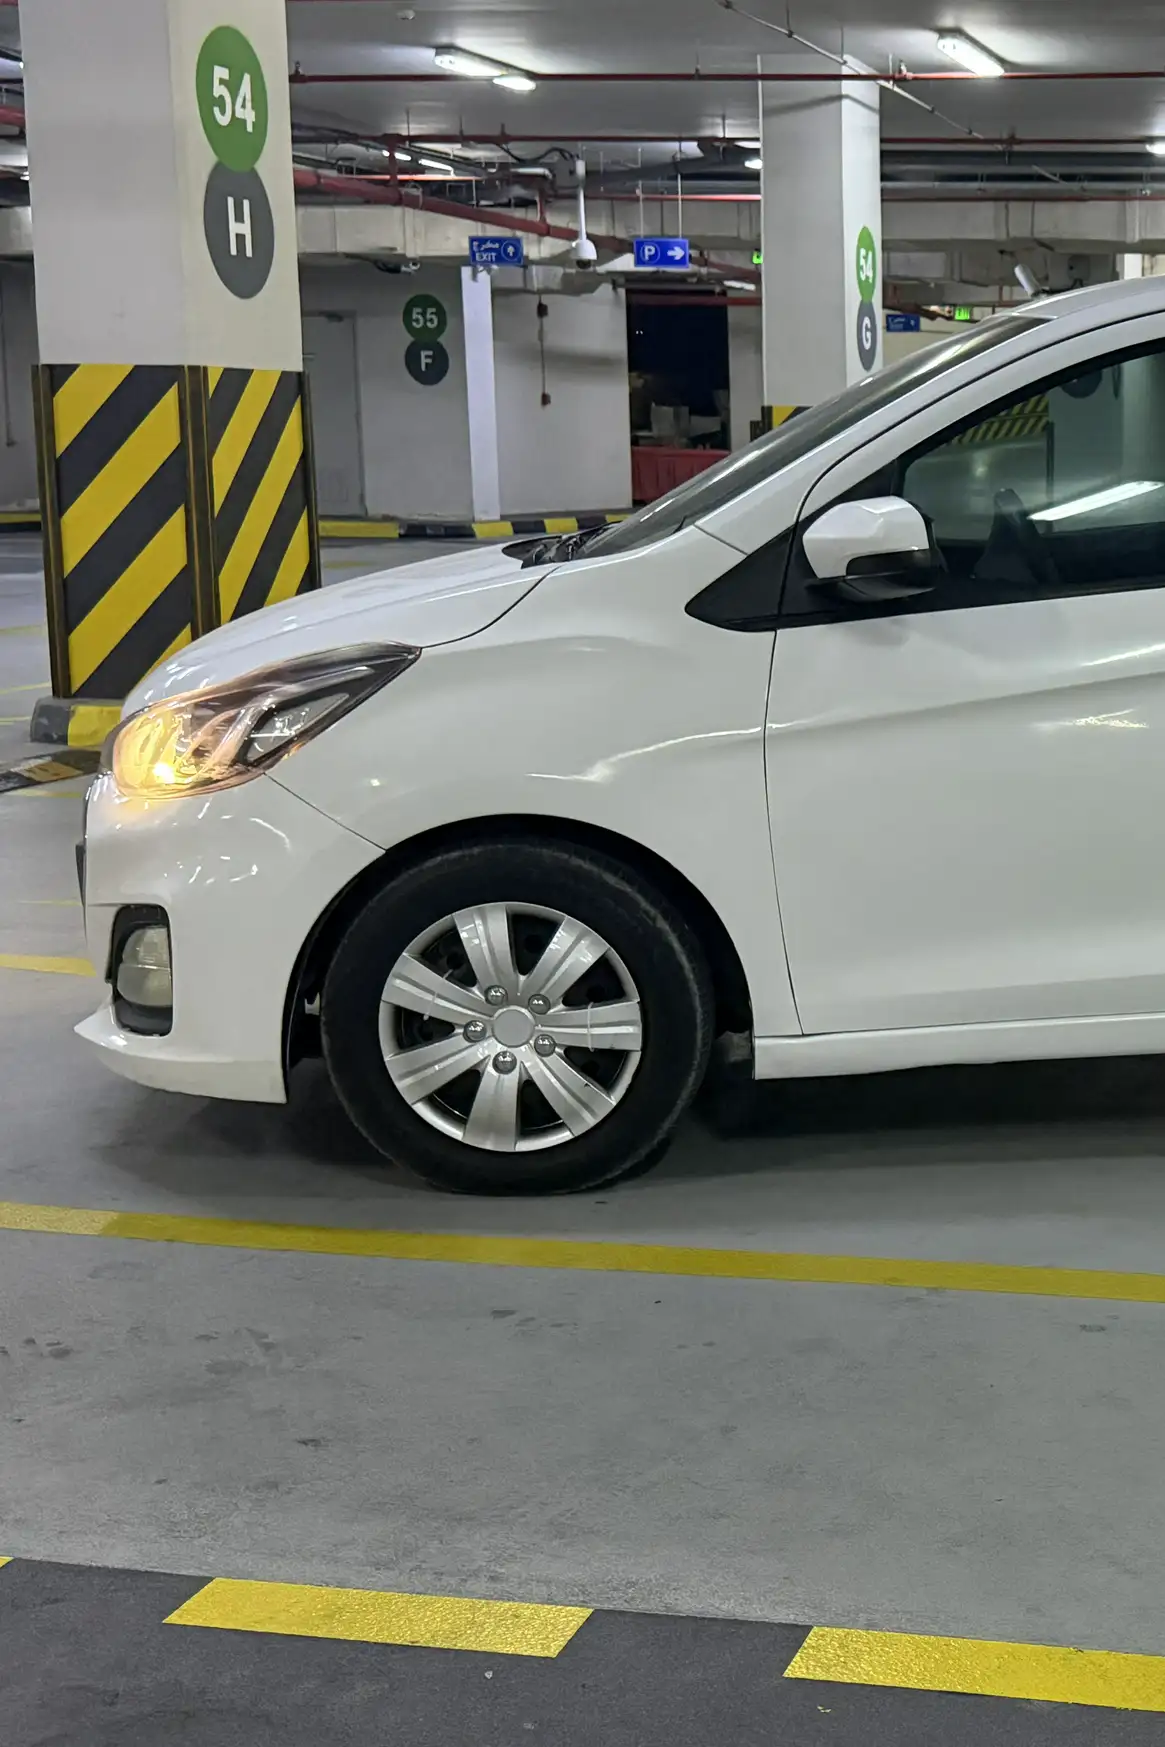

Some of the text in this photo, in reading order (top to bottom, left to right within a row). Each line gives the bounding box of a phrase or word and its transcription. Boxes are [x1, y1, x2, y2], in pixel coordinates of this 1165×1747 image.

[213, 64, 256, 133] 54
[227, 196, 253, 258] H
[475, 251, 497, 262] EXIT
[644, 245, 656, 261] P
[860, 247, 873, 284] 54
[411, 307, 438, 328] 55
[862, 316, 872, 350] G
[420, 349, 434, 372] F
